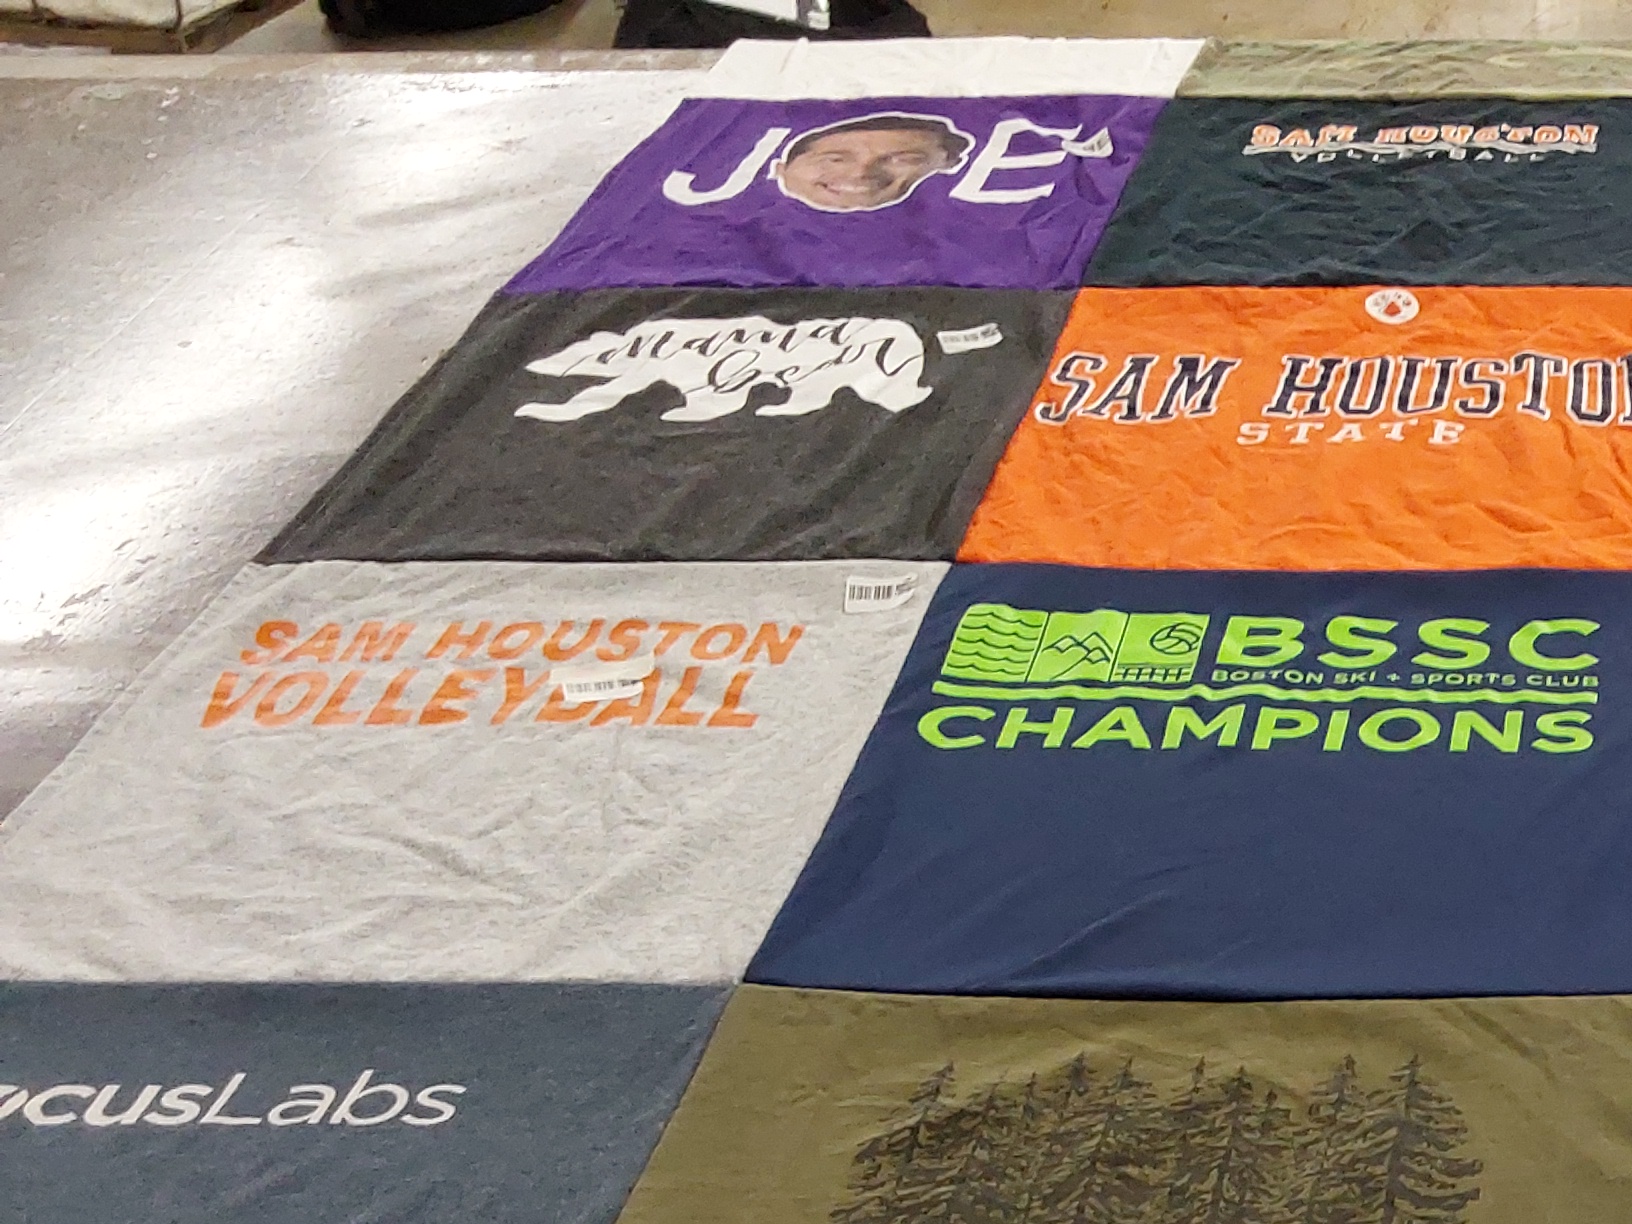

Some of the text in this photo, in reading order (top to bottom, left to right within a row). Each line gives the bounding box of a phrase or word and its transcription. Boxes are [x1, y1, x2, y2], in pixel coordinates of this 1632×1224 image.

[1251, 124, 1599, 148] SAM HOUSTON
[662, 111, 1083, 212] JE
[1033, 351, 1240, 425] SAM
[1236, 418, 1466, 446] STATE
[239, 619, 806, 665] SAM HOUSTON
[1217, 615, 1600, 668] BSSC
[198, 666, 760, 728] VOLLEYALL
[1211, 669, 1324, 685] BOSTON
[1333, 671, 1376, 684] SKI
[1410, 674, 1516, 686] SPORTS
[1526, 675, 1599, 687] CLUB
[917, 704, 1595, 753] CHAMPIONS
